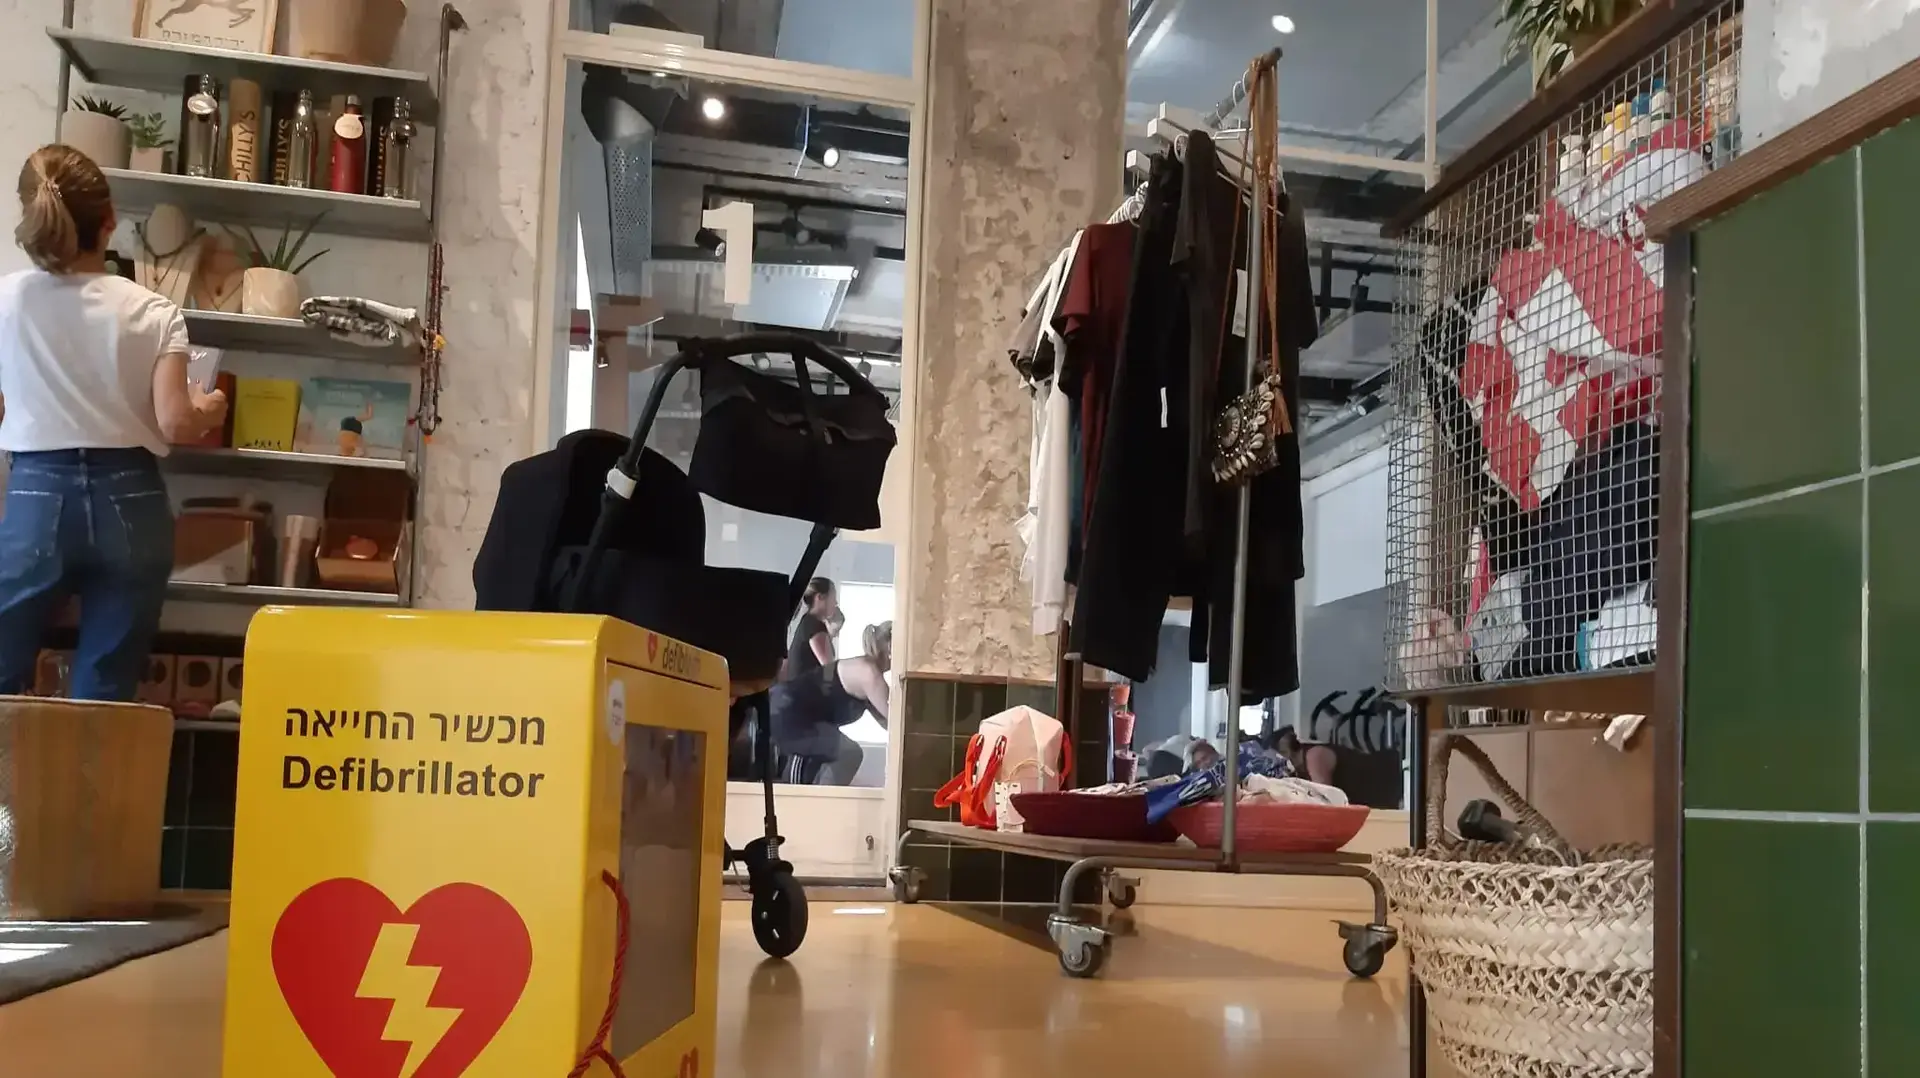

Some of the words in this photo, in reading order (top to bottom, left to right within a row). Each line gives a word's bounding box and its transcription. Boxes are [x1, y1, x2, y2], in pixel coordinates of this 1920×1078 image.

[702, 201, 754, 305] 1
[285, 708, 415, 741] החייאה
[429, 712, 545, 746] מכשיר
[282, 755, 545, 798] Defibrillator
